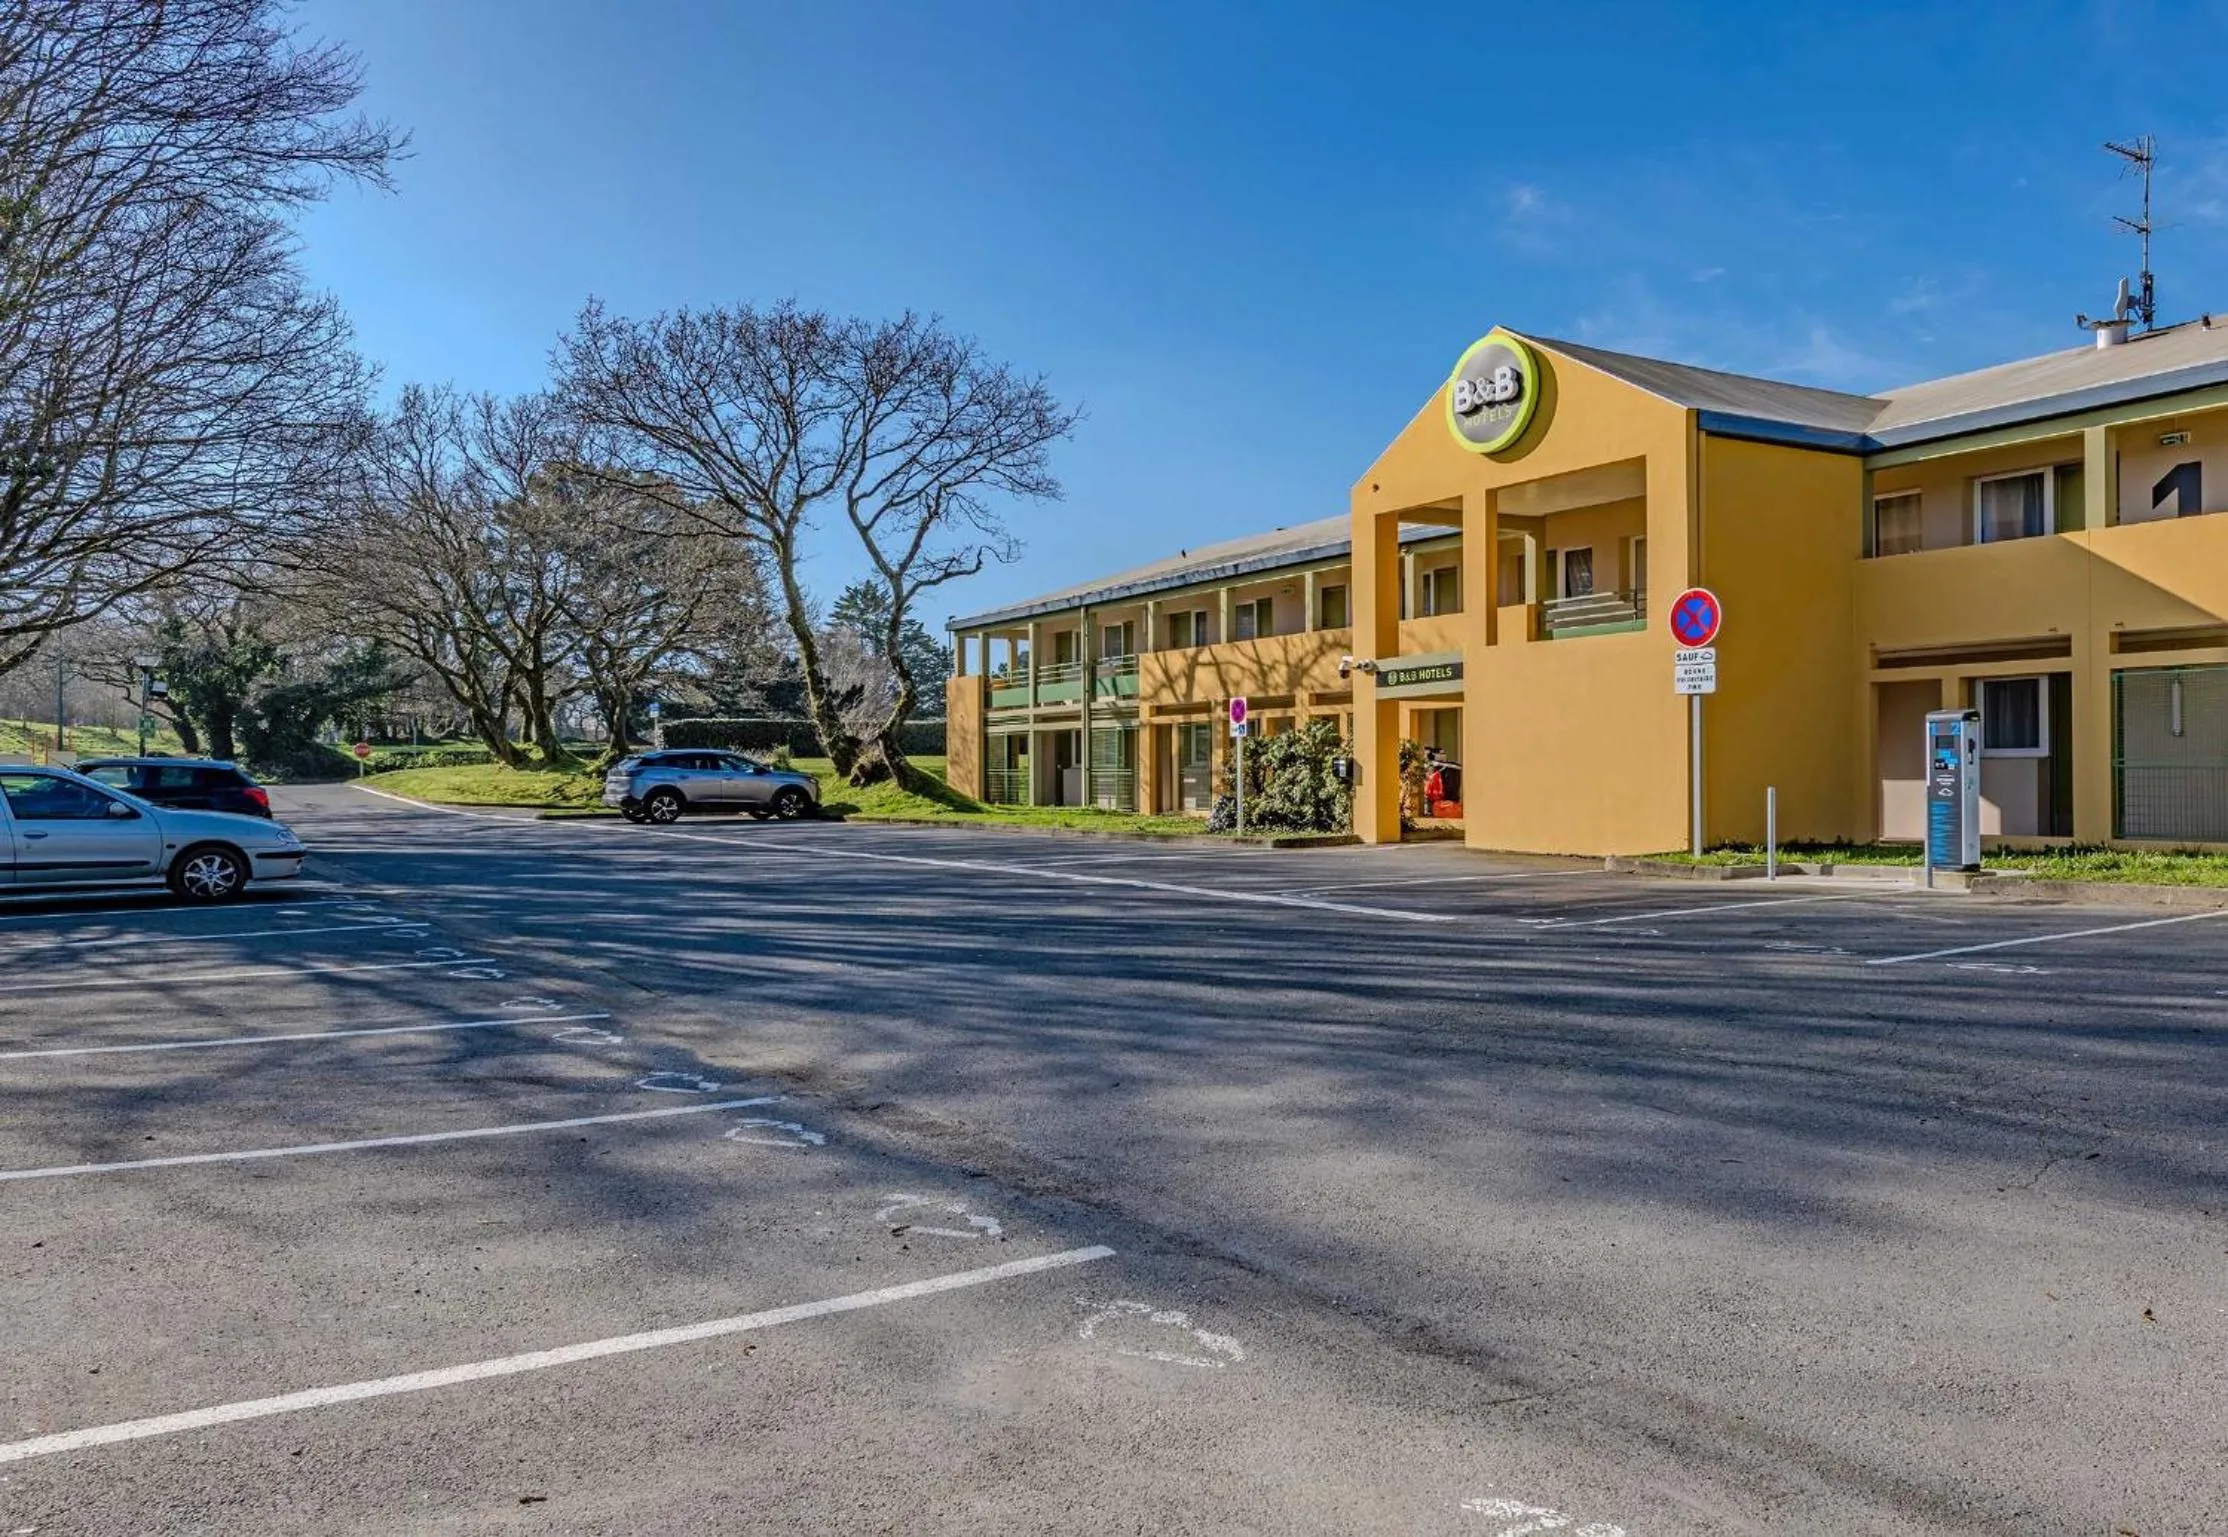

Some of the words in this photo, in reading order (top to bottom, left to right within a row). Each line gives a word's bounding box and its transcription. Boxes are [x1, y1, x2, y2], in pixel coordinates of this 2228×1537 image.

[1455, 366, 1519, 414] B&B
[1463, 403, 1512, 428] HOTELS
[2152, 461, 2202, 518] 1
[1676, 652, 1698, 662] SAUF
[1419, 667, 1452, 680] HOTELS
[1951, 721, 1961, 736] 2
